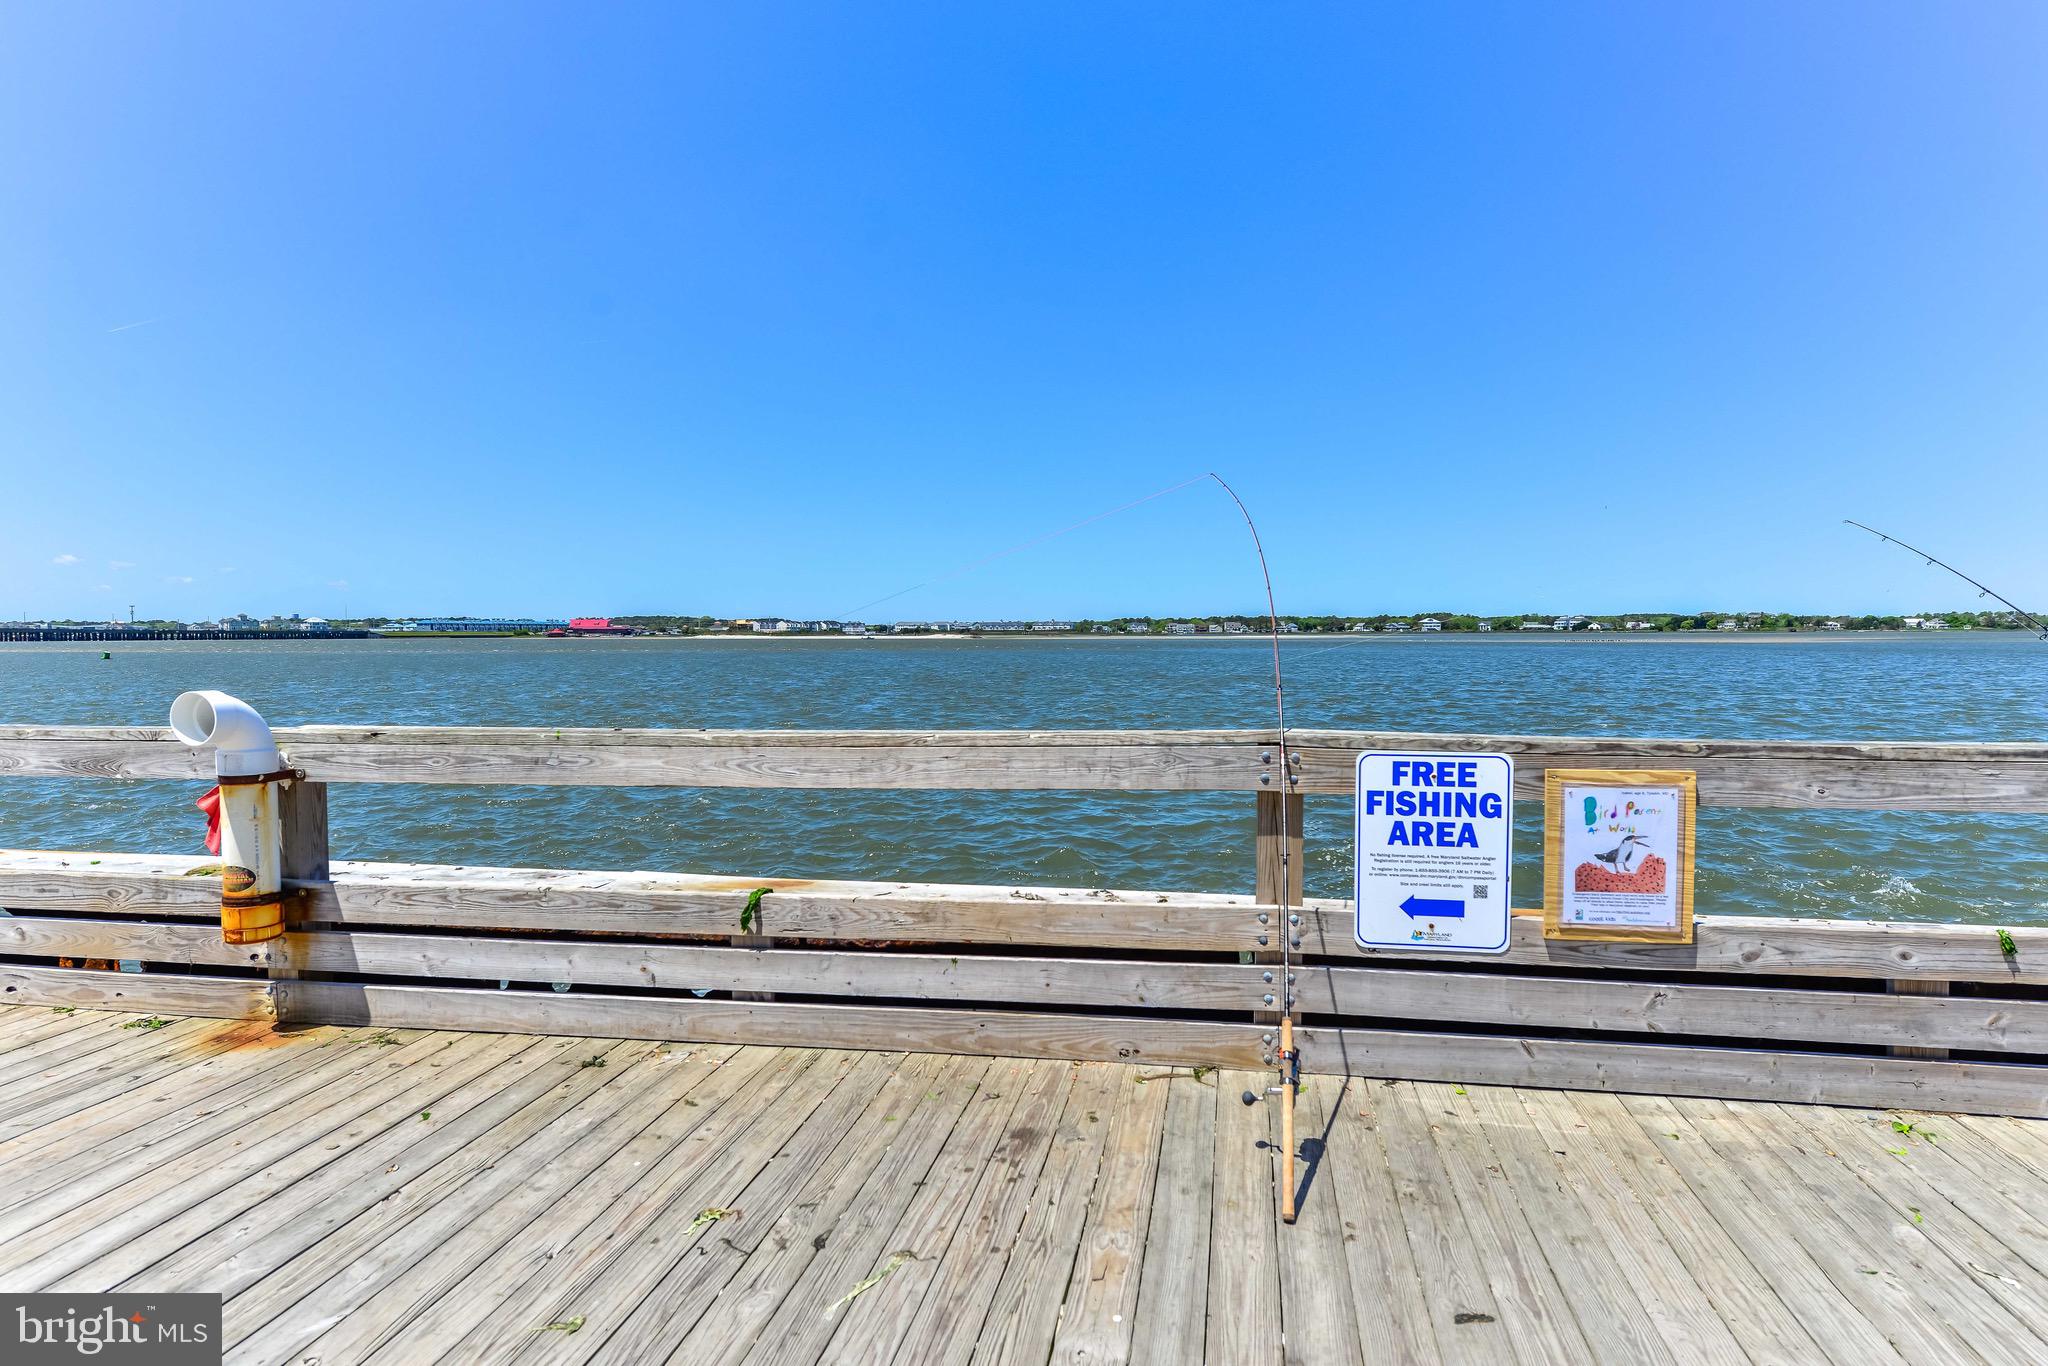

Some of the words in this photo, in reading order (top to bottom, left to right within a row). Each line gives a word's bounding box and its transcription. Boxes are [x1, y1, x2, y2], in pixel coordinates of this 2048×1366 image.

[1392, 761, 1477, 788] FREE
[1366, 790, 1502, 818] FISHING
[1584, 796, 1618, 826] Bird
[1388, 821, 1479, 848] AREA
